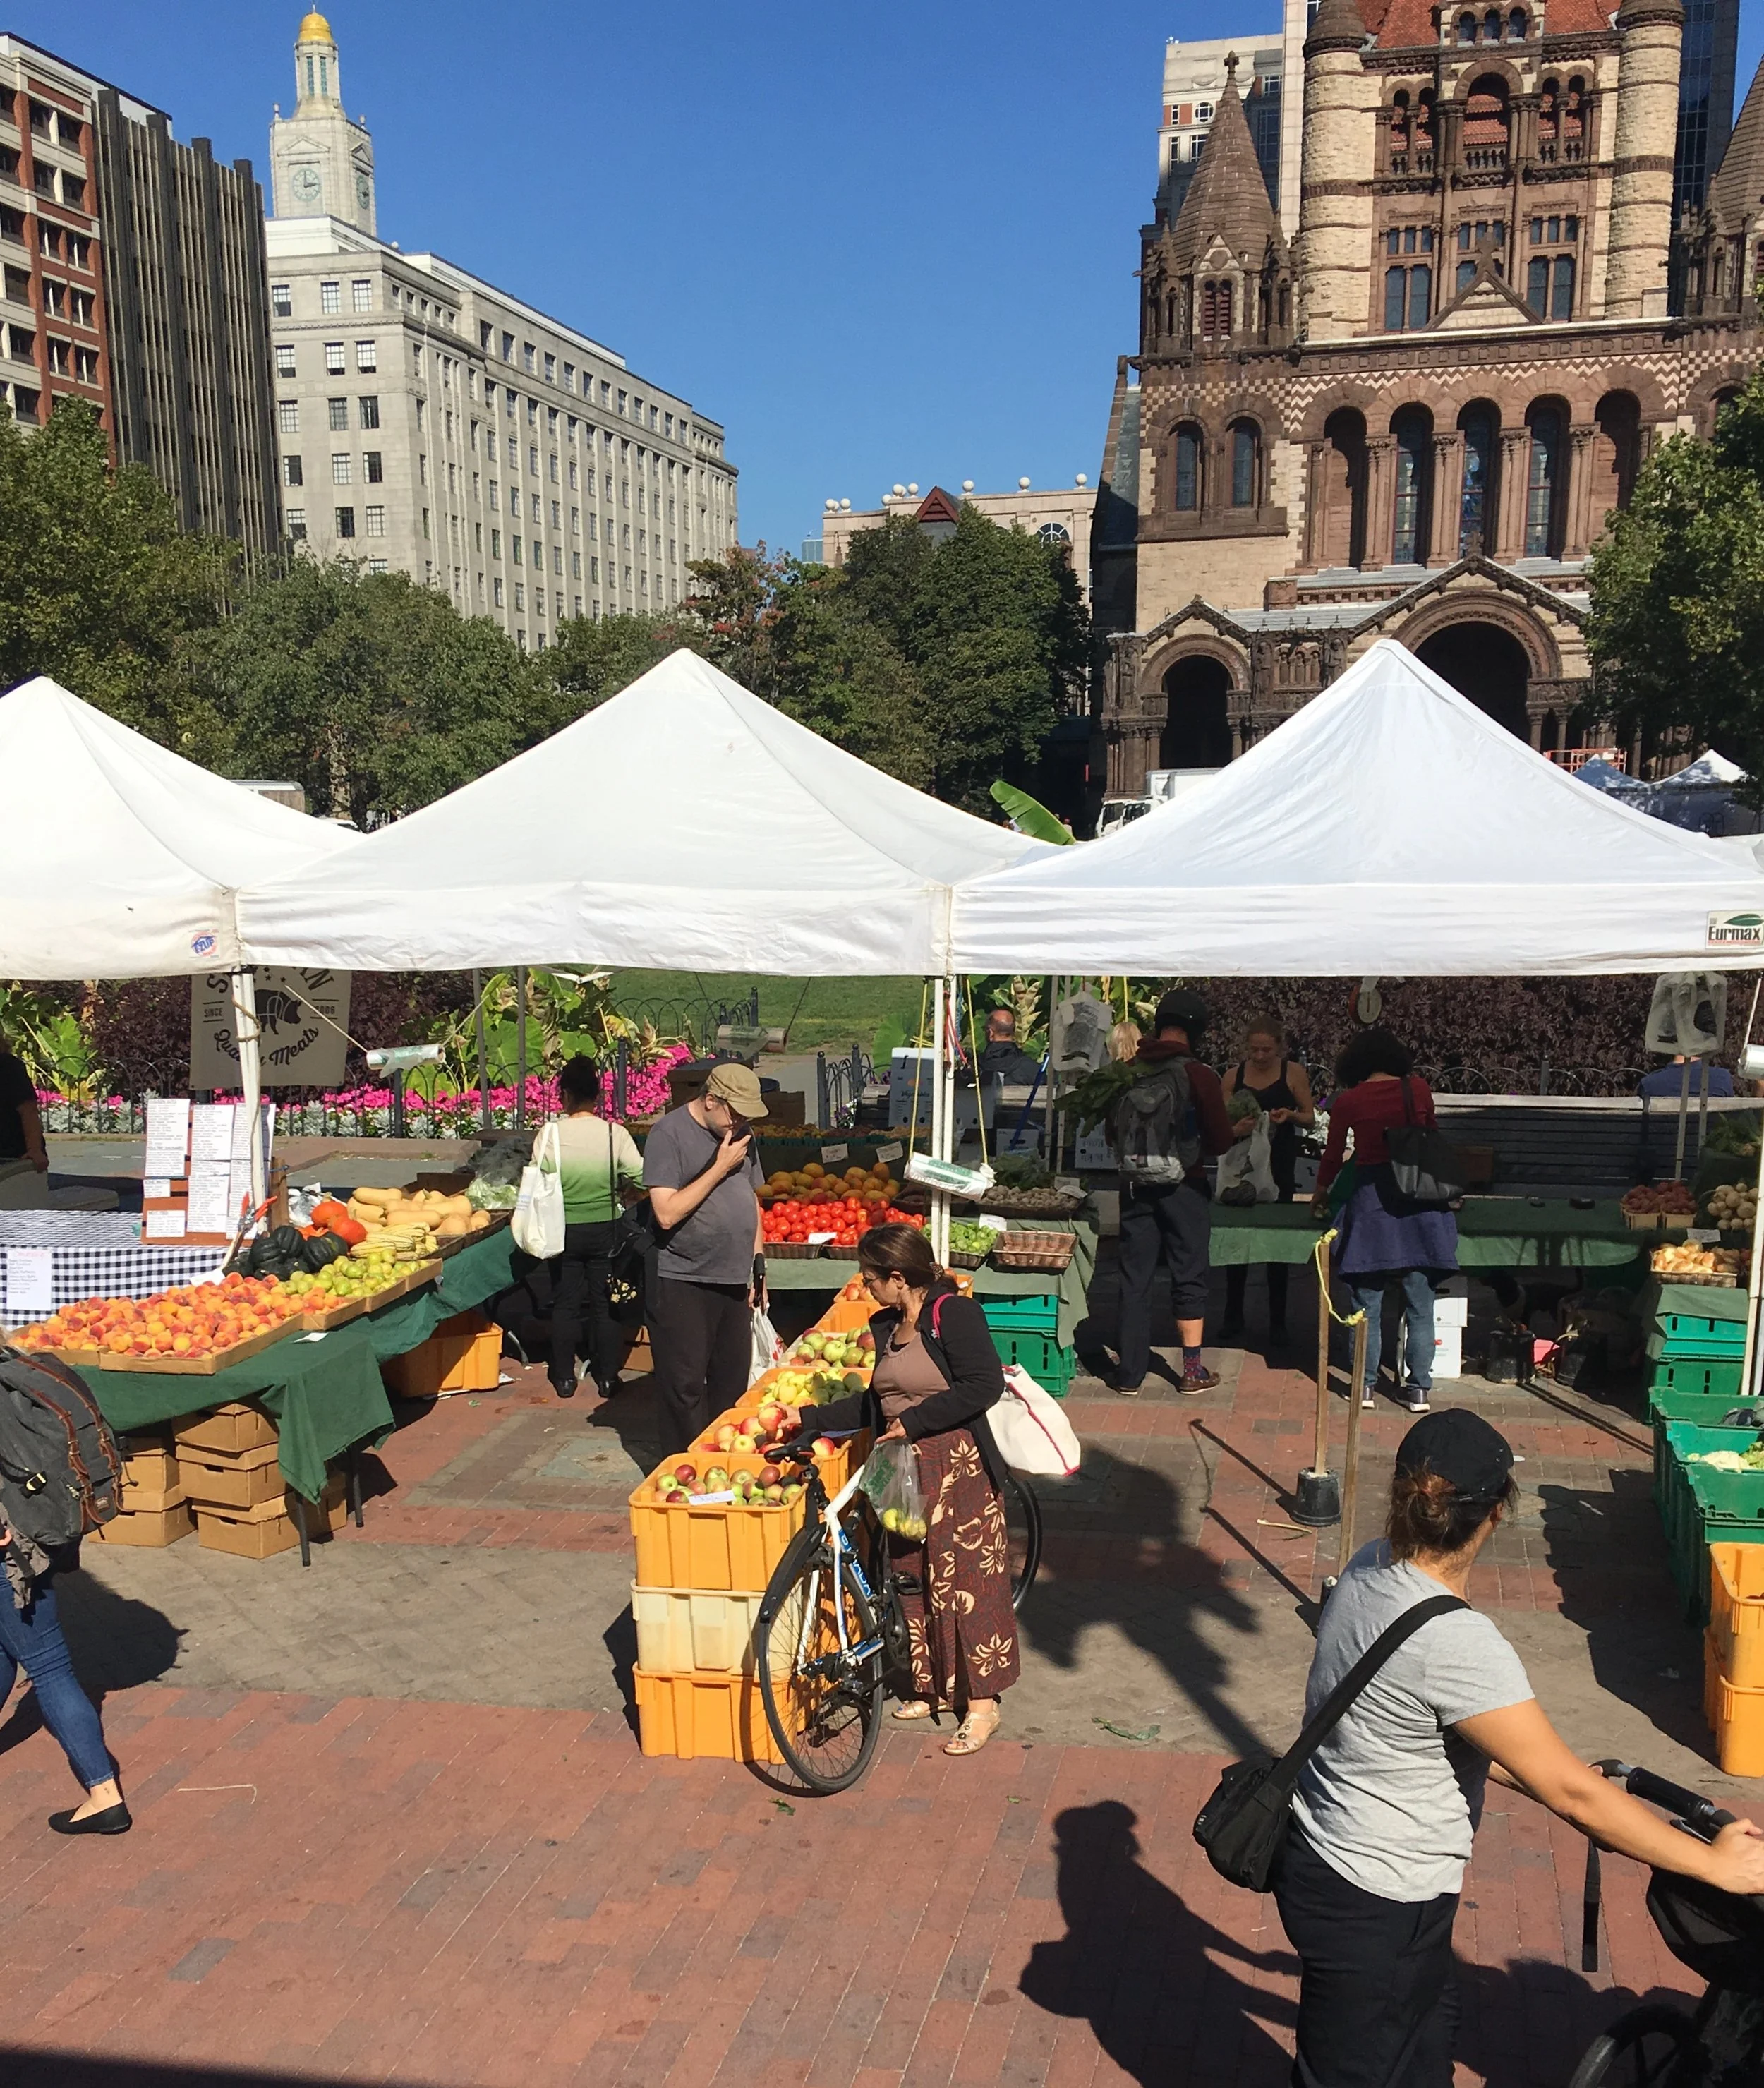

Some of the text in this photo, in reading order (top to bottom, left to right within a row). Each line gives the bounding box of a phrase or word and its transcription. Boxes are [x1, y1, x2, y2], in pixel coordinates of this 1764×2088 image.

[1708, 926, 1761, 941] Eurmax
[204, 1007, 223, 1017] SINCE
[269, 1027, 319, 1066] Meats
